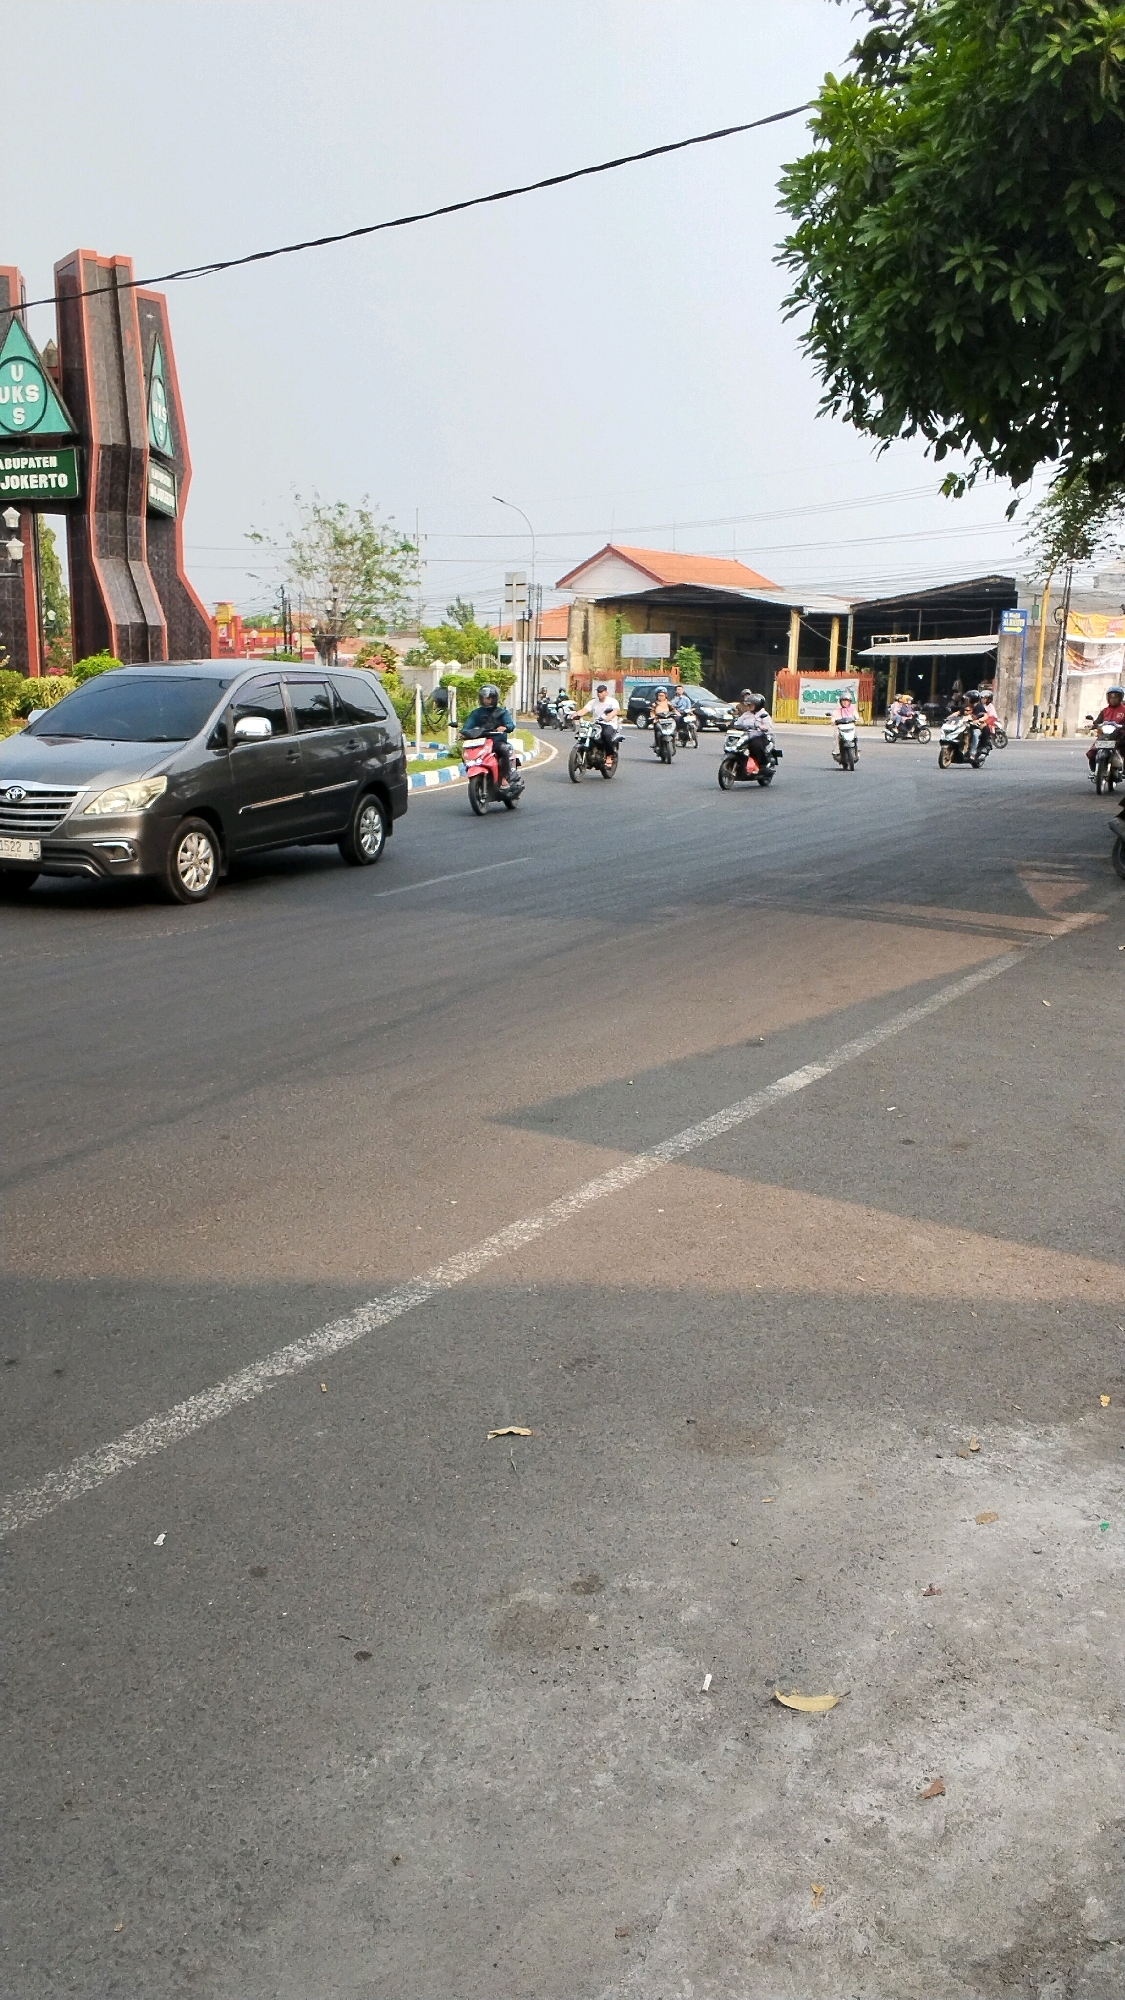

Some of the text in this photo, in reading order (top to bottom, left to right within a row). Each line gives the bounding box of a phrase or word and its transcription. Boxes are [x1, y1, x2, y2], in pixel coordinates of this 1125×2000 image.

[11, 364, 24, 381] U
[0, 385, 40, 403] UKS
[12, 407, 25, 424] S
[0, 473, 68, 490] JOKERTO
